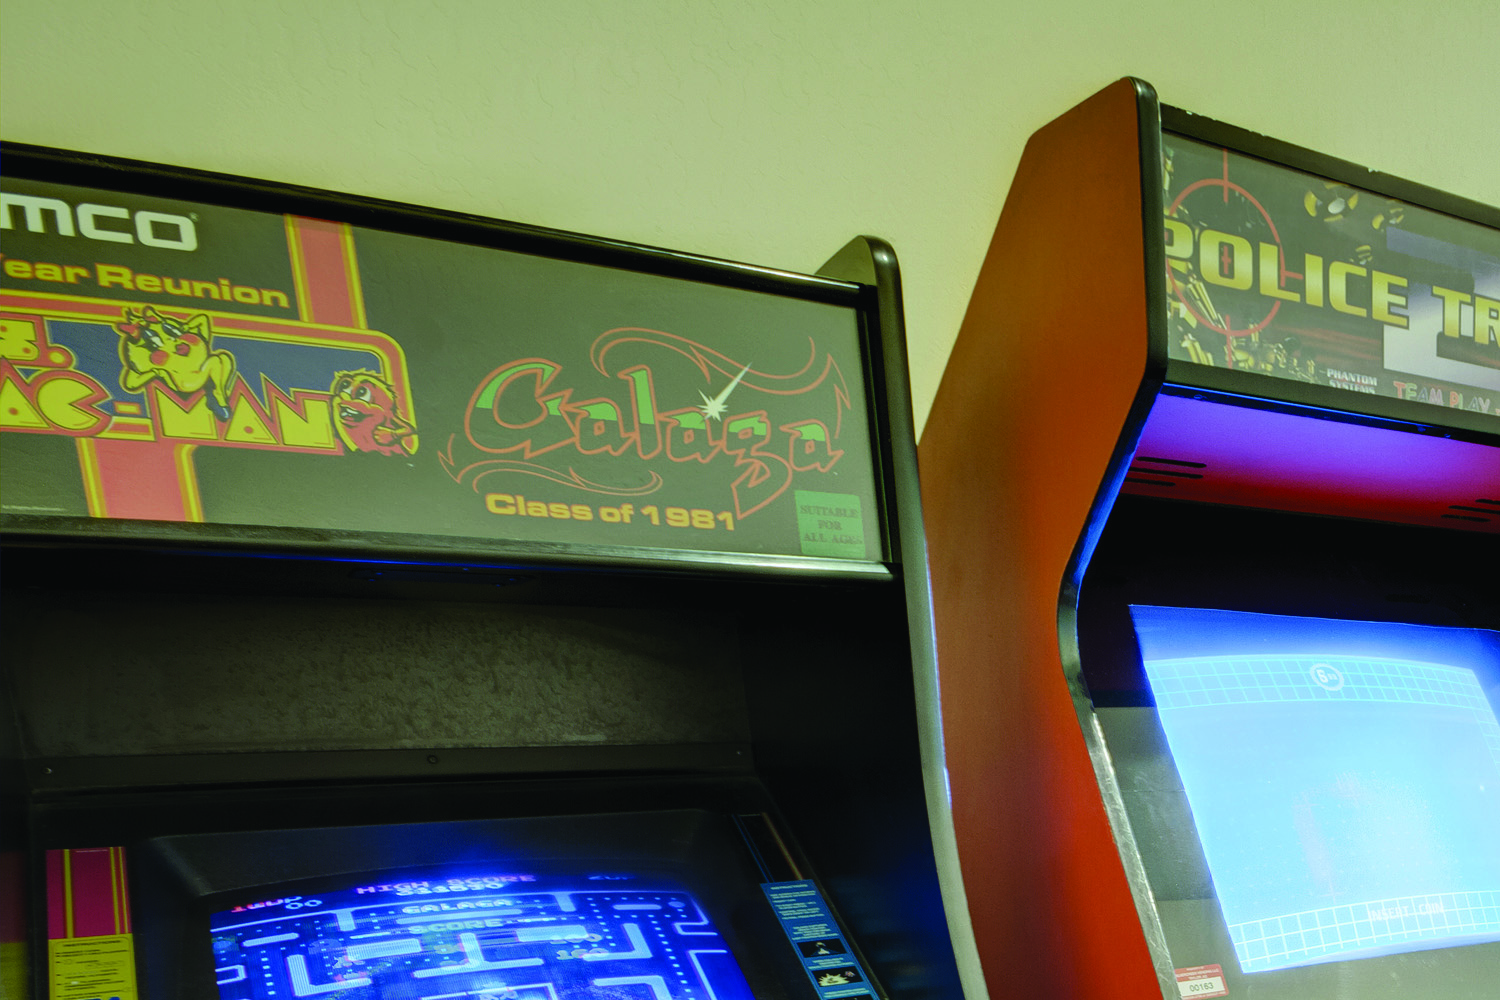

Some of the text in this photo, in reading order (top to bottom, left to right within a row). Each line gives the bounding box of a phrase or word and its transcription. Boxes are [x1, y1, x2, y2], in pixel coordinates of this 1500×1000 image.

[0, 192, 198, 252] mco
[0, 254, 290, 308] ear Reunion
[1164, 218, 1409, 330] POLICE
[1326, 368, 1378, 386] PHANTOM
[1392, 380, 1444, 407] TEAM
[1449, 390, 1491, 414] PLAY
[0, 358, 346, 460] AC-MAN
[464, 357, 845, 521] Galaga
[485, 492, 736, 531] Class of 1981
[799, 504, 859, 519] SUITABLE
[817, 519, 843, 531] FOR
[803, 532, 828, 543] ALL
[355, 880, 430, 895] HIGH
[401, 899, 514, 914] GALAGA
[408, 918, 503, 934] SCORE
[1189, 982, 1214, 992] 00163
